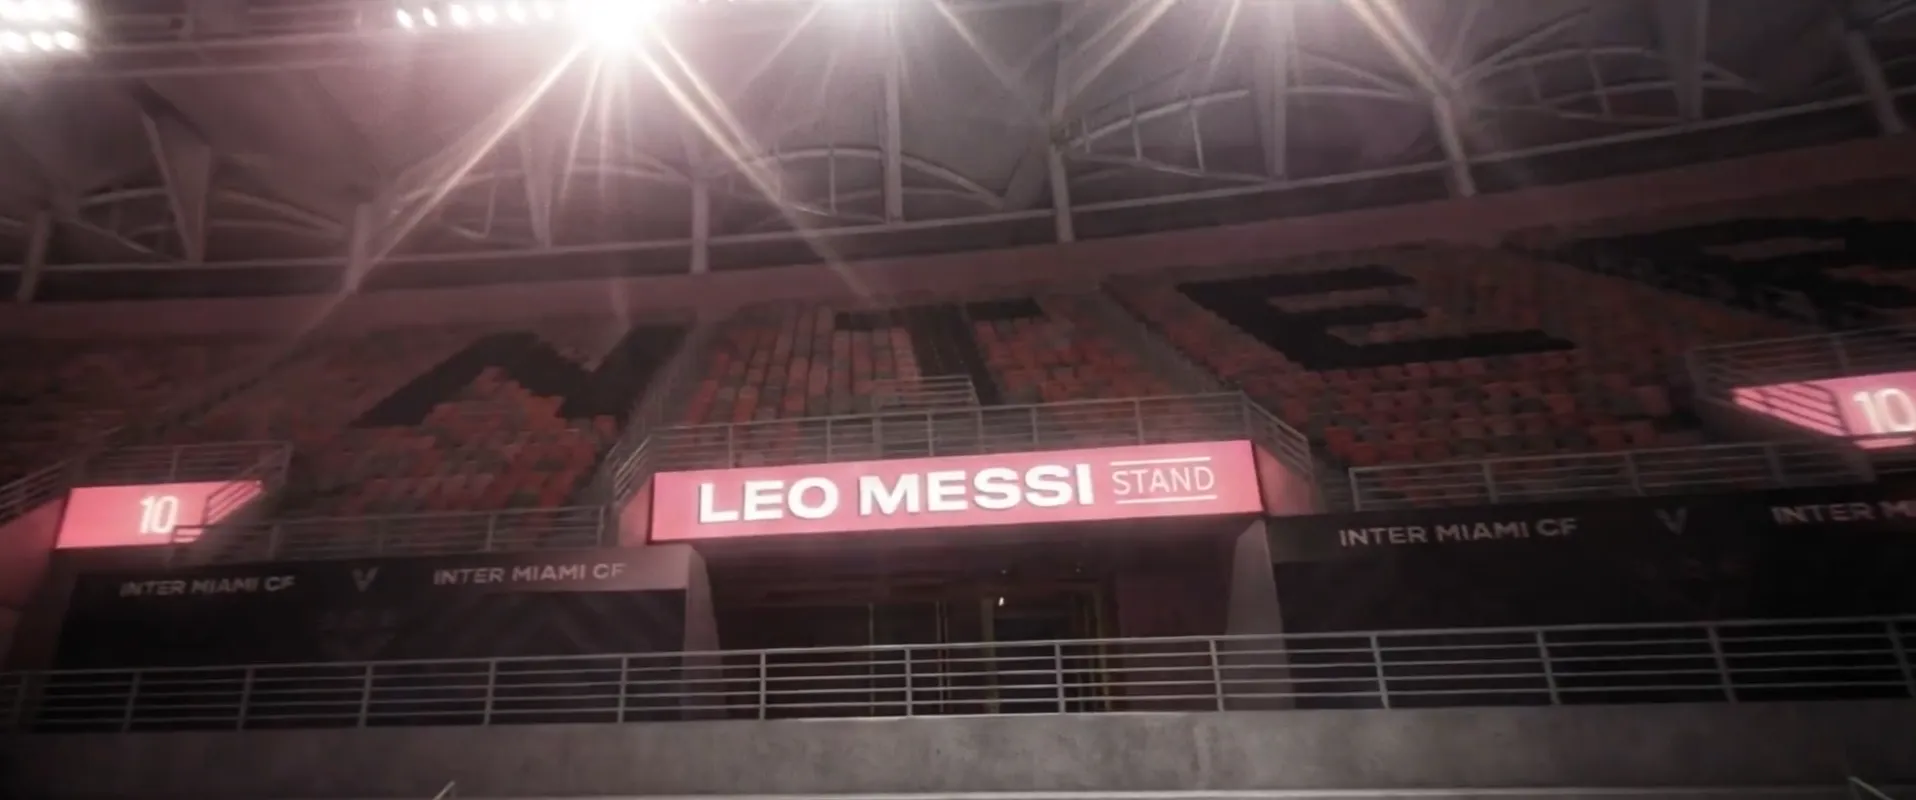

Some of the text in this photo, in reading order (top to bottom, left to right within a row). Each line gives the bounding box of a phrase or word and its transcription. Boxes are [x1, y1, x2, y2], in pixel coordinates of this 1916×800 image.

[1852, 387, 1916, 434] 10
[139, 495, 178, 534] 10
[699, 463, 1215, 523] LEO MESSI STAND
[1338, 525, 1428, 547] INTER
[1434, 520, 1530, 542] MIAMI
[1534, 516, 1579, 537] CF
[1770, 502, 1876, 525] INTER
[118, 579, 187, 598] INTER
[190, 576, 260, 594] MIAMI
[263, 574, 296, 592] CF
[433, 566, 505, 586] INTER
[511, 563, 586, 583] MIAMI
[591, 562, 626, 580] CF
